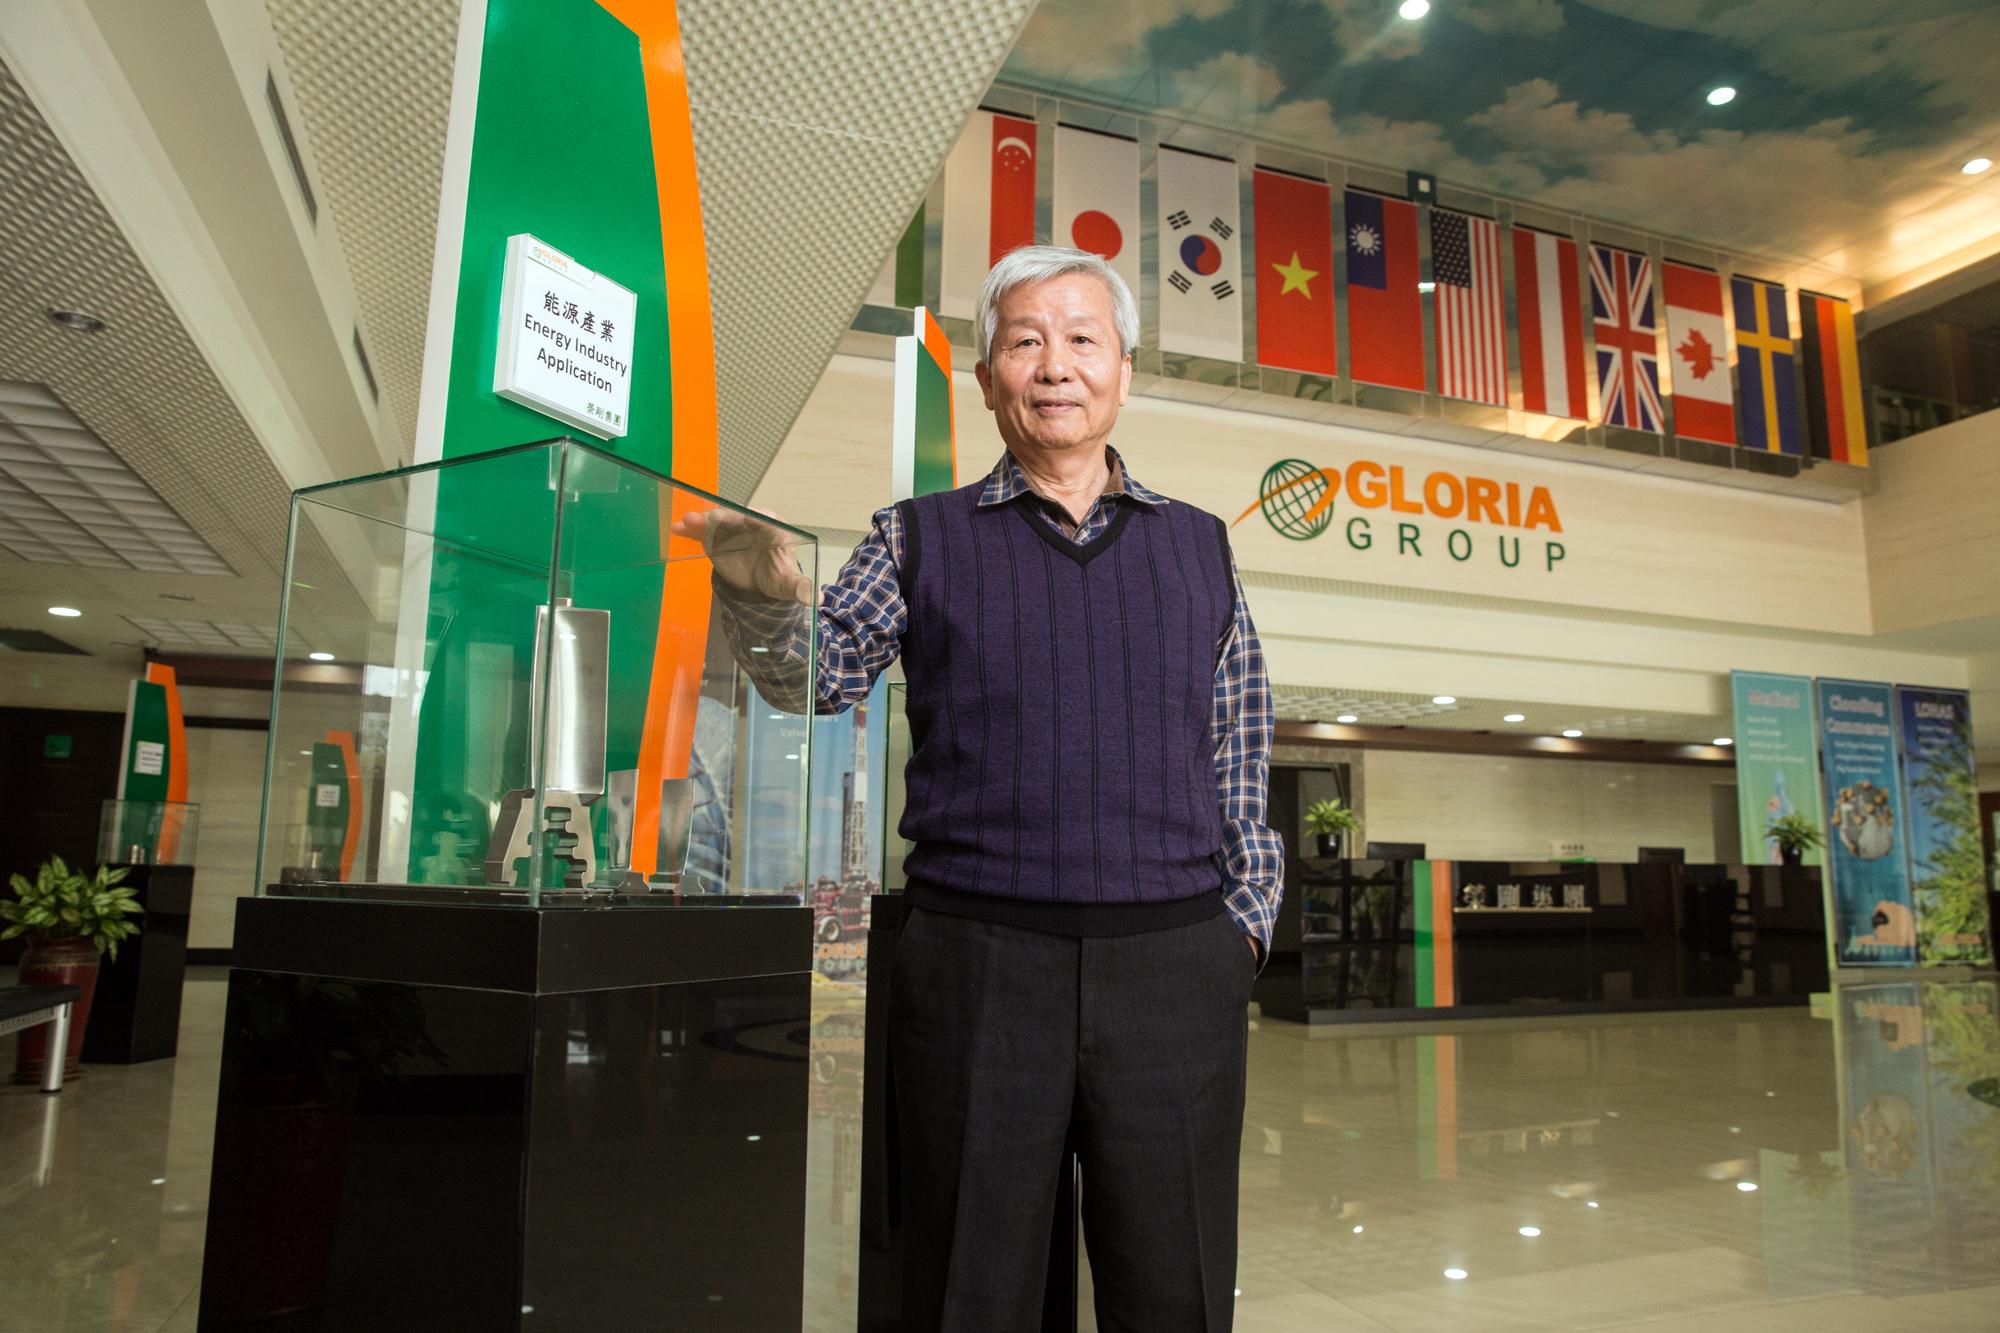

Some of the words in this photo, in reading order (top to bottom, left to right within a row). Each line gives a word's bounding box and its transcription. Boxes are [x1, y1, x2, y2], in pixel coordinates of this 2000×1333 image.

[543, 291, 615, 343] 能源產業
[525, 313, 572, 351] Energy
[575, 338, 628, 377] Industry
[537, 347, 613, 394] Application
[1345, 460, 1564, 533] GLORIA
[1346, 517, 1566, 572] GROUP
